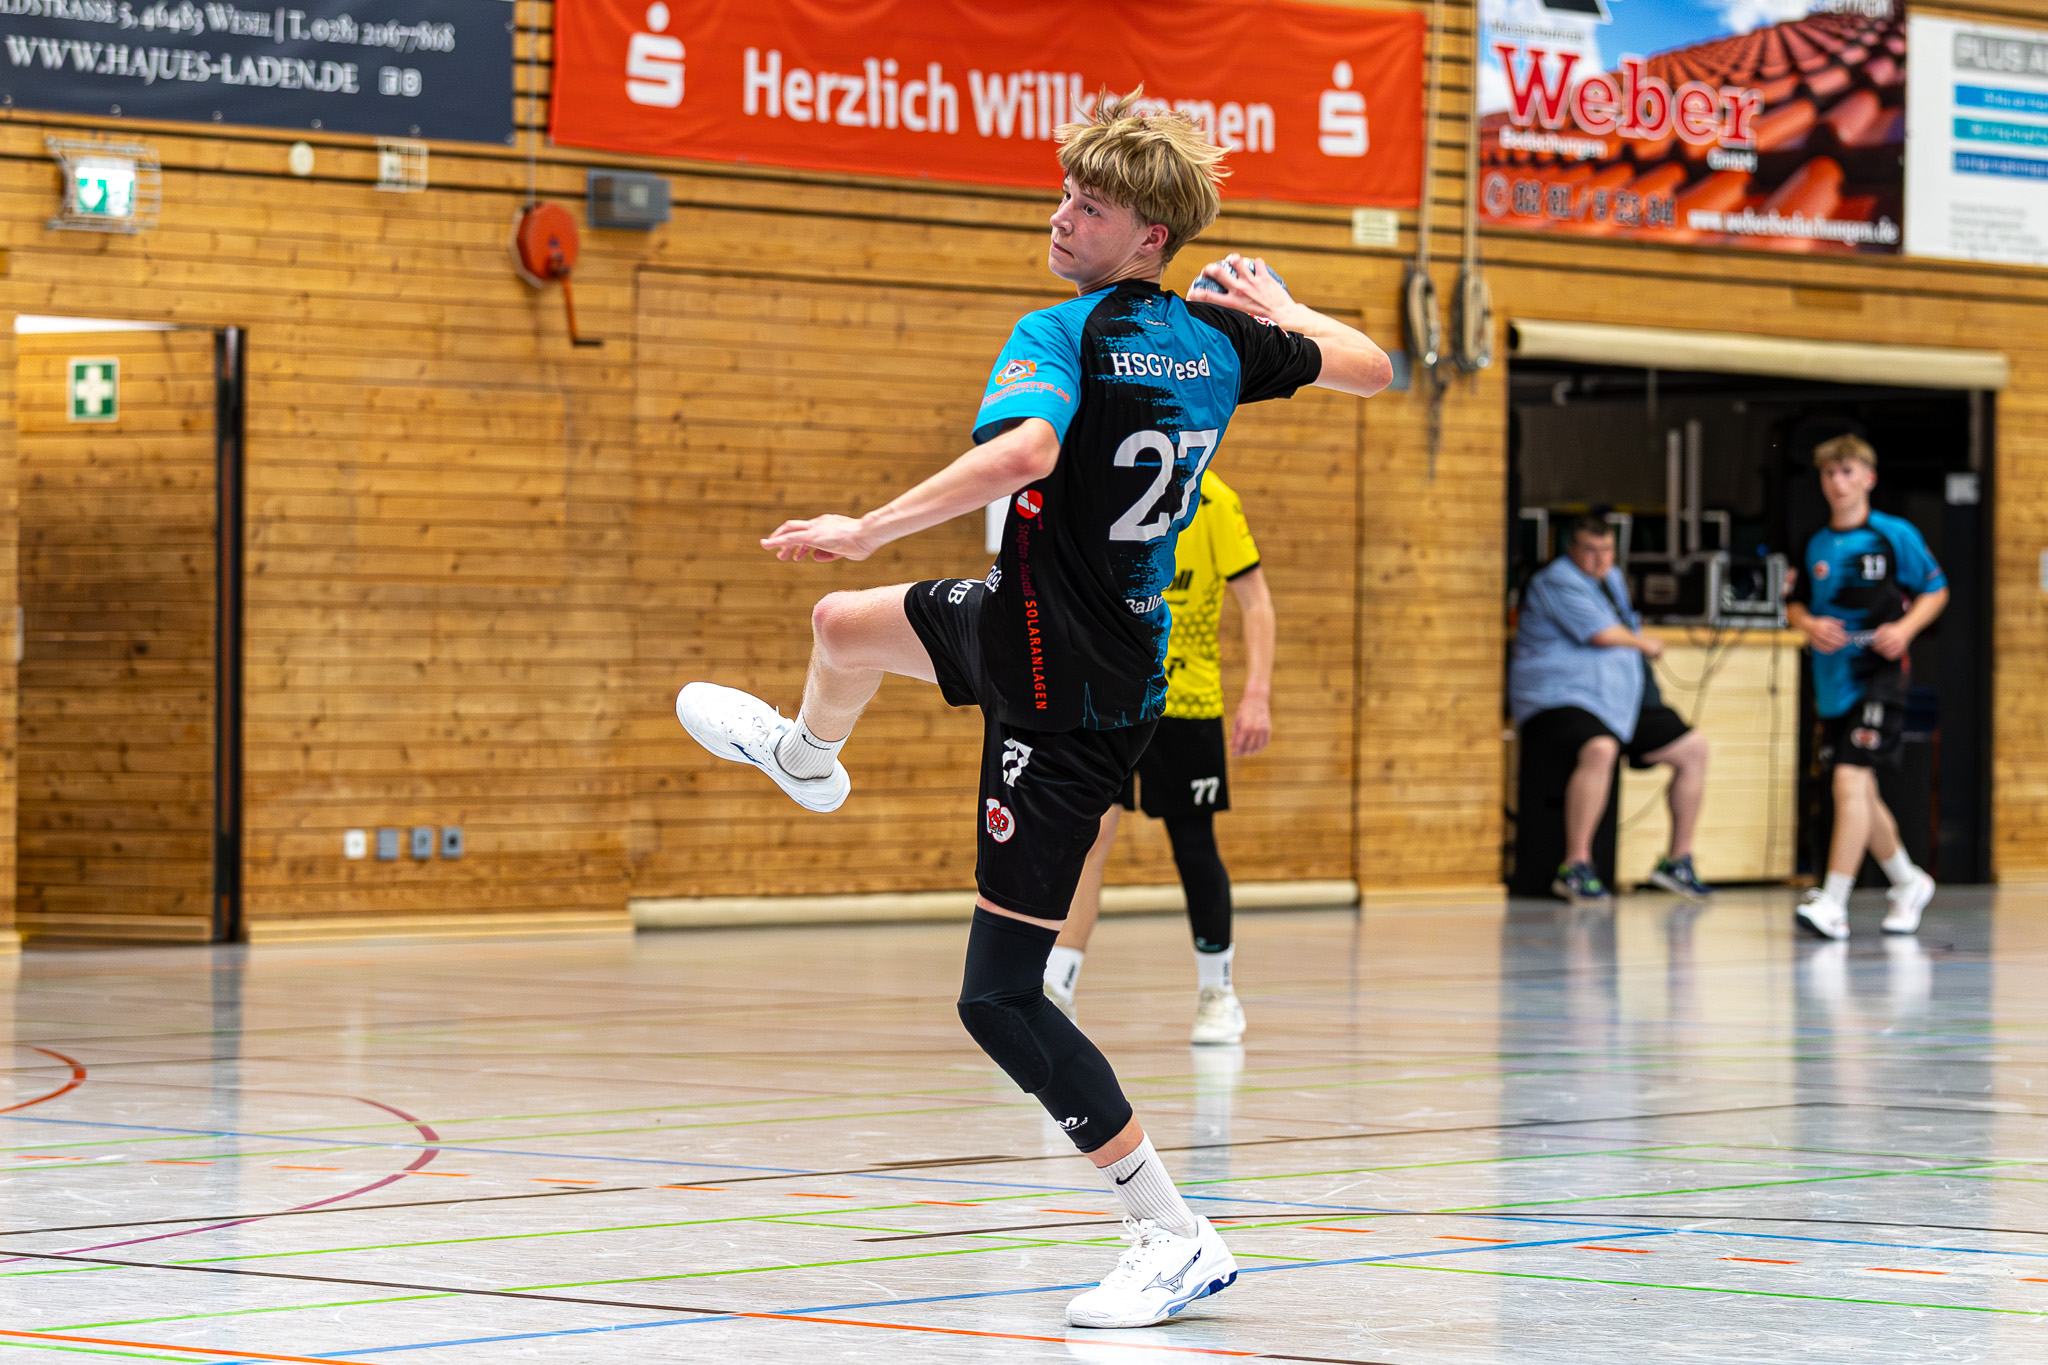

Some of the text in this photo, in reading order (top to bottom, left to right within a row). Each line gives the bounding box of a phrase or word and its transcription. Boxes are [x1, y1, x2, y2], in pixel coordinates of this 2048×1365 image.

[743, 47, 958, 136] Herzlich
[1493, 43, 1763, 149] Weber
[1110, 352, 1163, 377] HSG
[1110, 429, 1218, 541] 27
[1025, 600, 1048, 711] SOLARANLAGEN
[1191, 776, 1220, 806] 77
